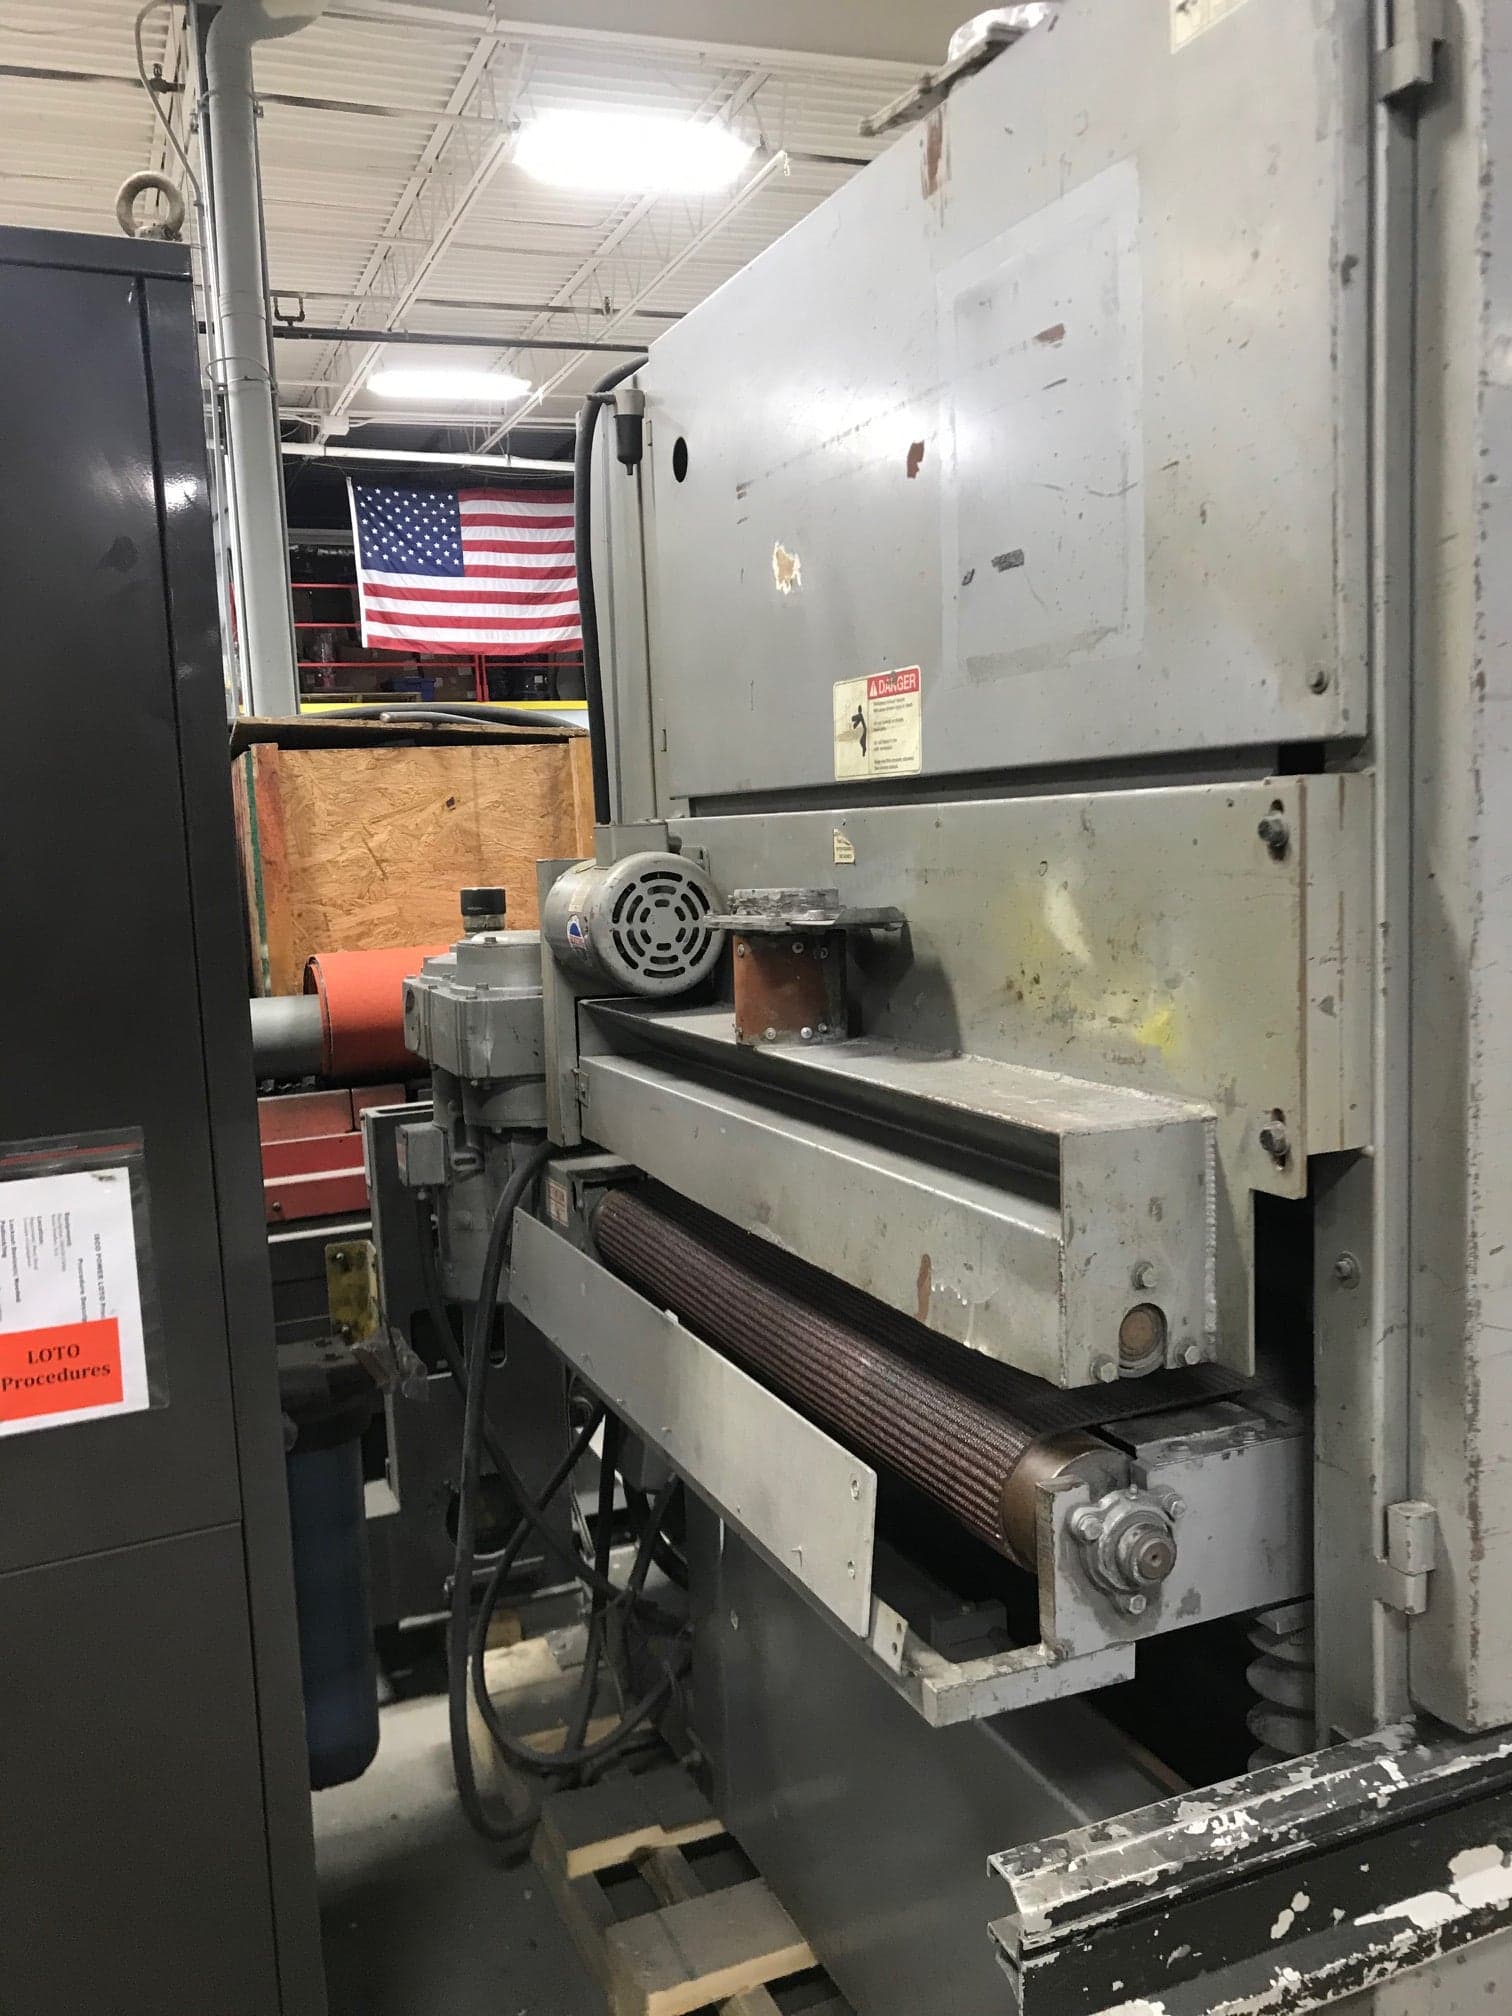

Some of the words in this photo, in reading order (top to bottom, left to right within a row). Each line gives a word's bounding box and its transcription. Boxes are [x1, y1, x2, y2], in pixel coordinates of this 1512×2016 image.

[878, 673, 916, 695] DANGER
[27, 1344, 81, 1365] LOTO
[1, 1364, 112, 1392] Procedures
